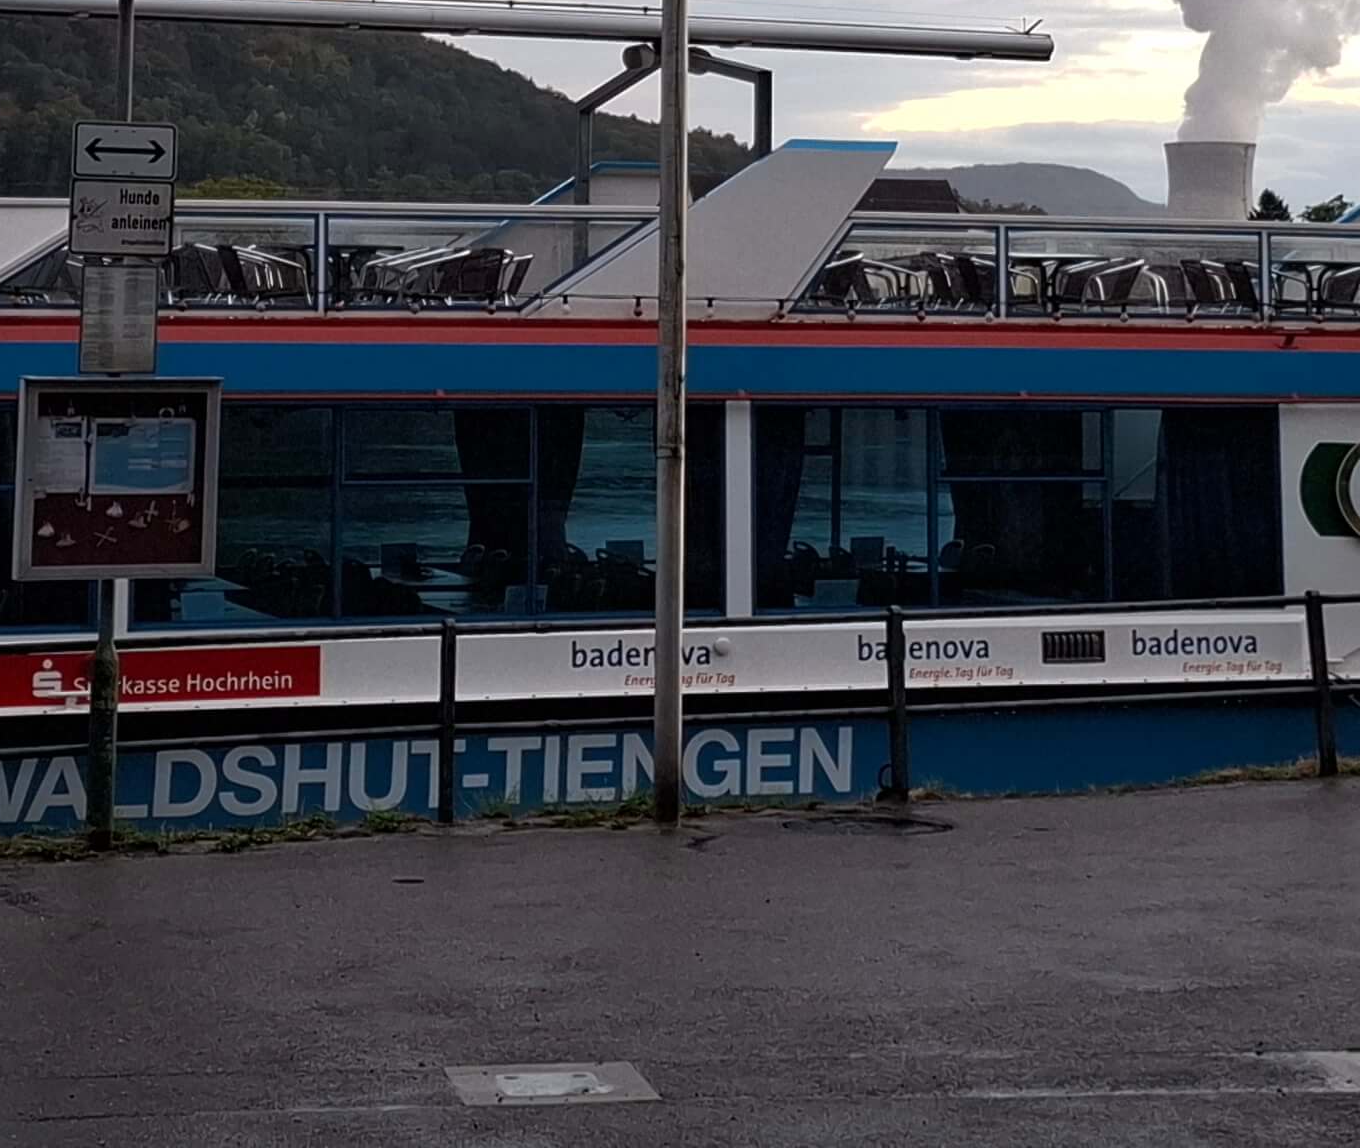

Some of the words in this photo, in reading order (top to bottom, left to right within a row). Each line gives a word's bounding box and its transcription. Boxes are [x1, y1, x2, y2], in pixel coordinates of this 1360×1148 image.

[111, 214, 167, 231] anleinen
[572, 639, 710, 668] badenva
[858, 634, 989, 661] baenova
[1131, 628, 1258, 657] badenova
[187, 670, 293, 692] Hochrhein
[696, 672, 713, 684] für
[716, 673, 735, 687] Tag
[955, 667, 973, 680] Tag
[976, 665, 993, 677] für
[995, 665, 1014, 679] Tag
